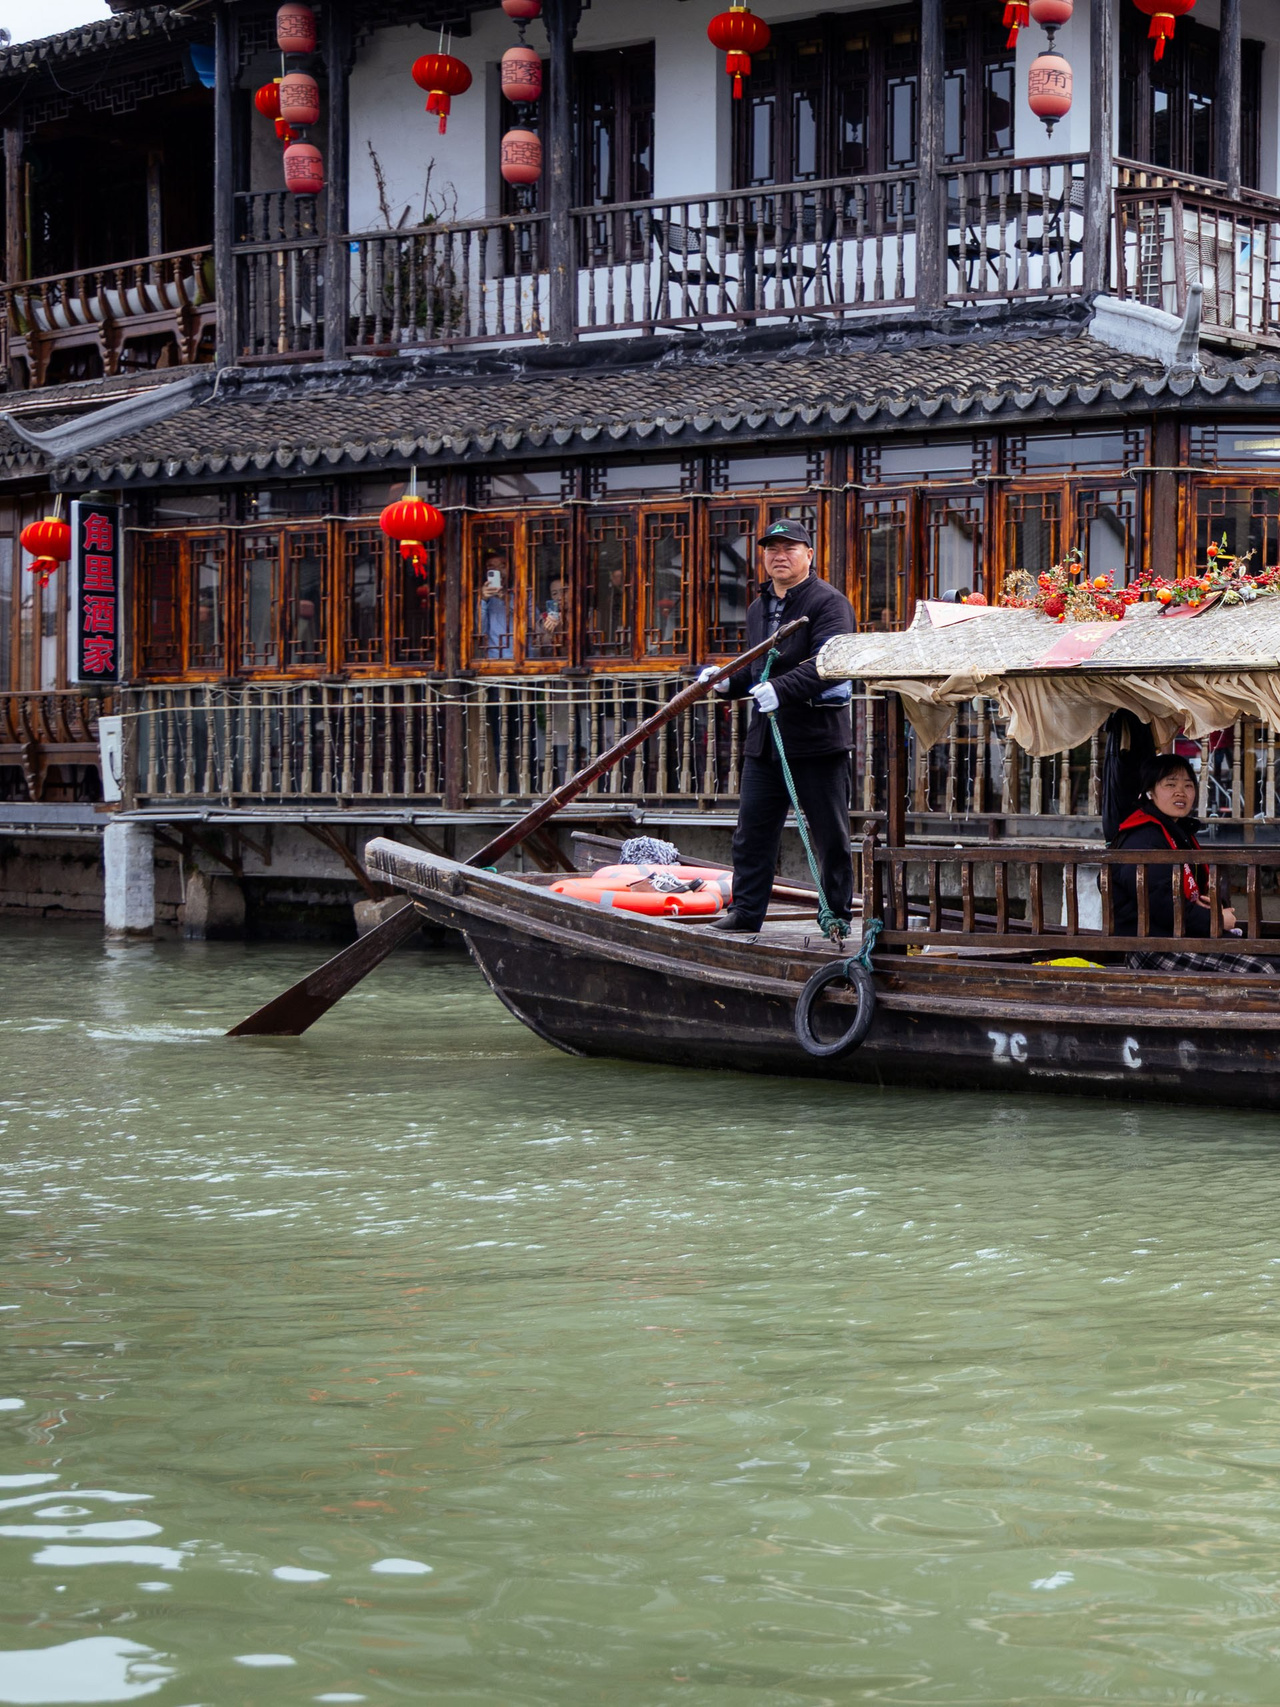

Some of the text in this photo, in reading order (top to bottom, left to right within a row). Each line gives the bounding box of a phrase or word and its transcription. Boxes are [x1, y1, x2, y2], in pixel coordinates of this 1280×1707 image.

[1042, 69, 1066, 88] 角
[83, 512, 115, 673] 角里酒家
